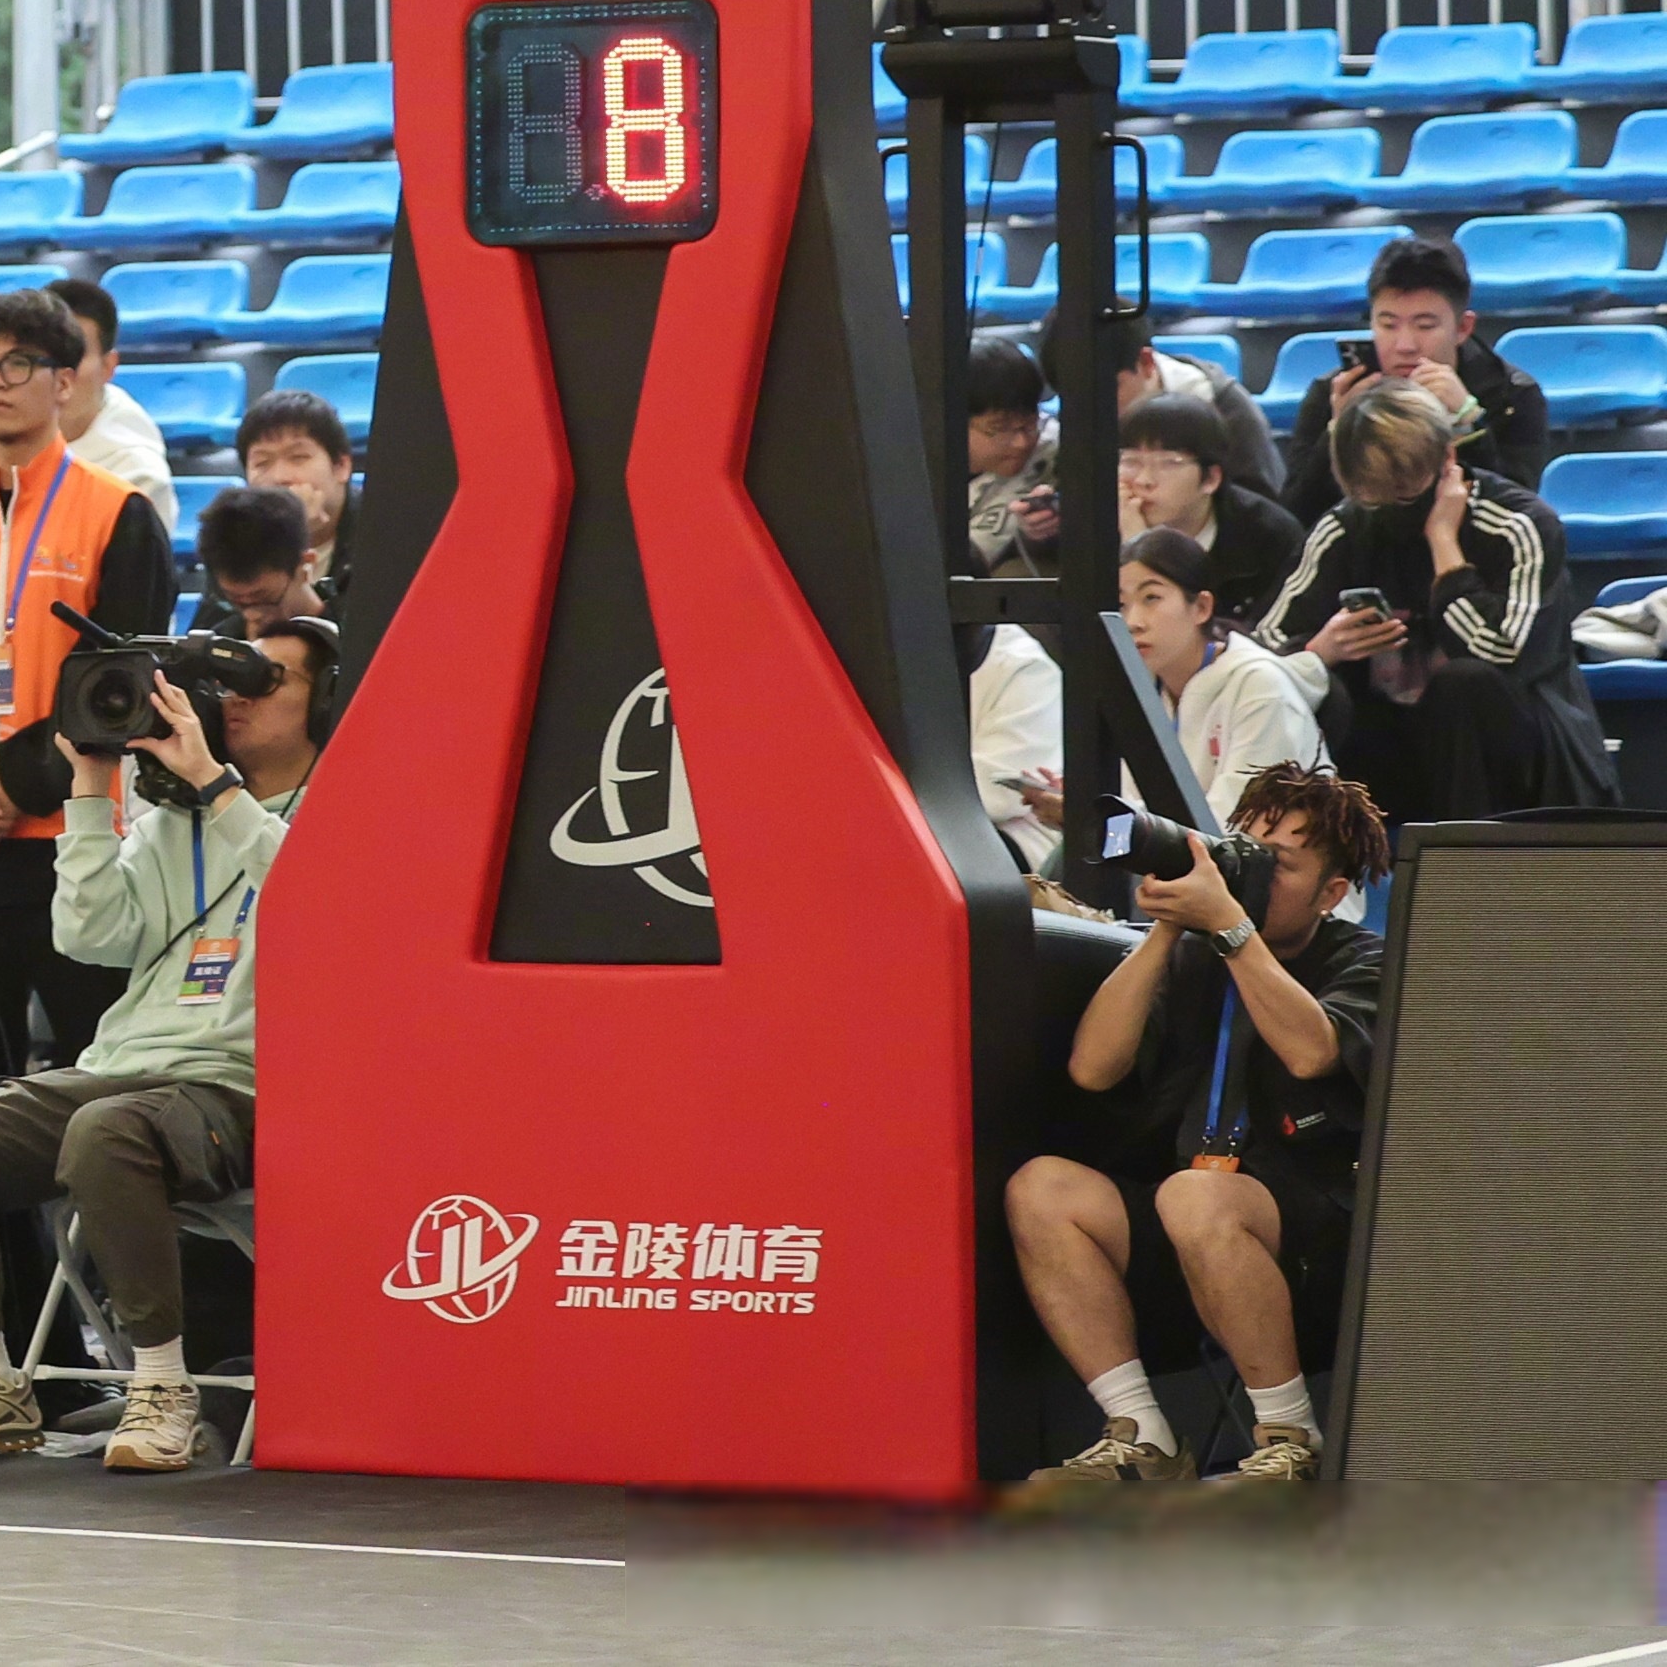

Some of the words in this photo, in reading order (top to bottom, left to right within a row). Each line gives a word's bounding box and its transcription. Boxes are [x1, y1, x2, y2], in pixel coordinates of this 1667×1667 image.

[603, 37, 686, 202] 8
[555, 1220, 824, 1283] 金陵体育
[688, 1289, 817, 1314] SPORTS
